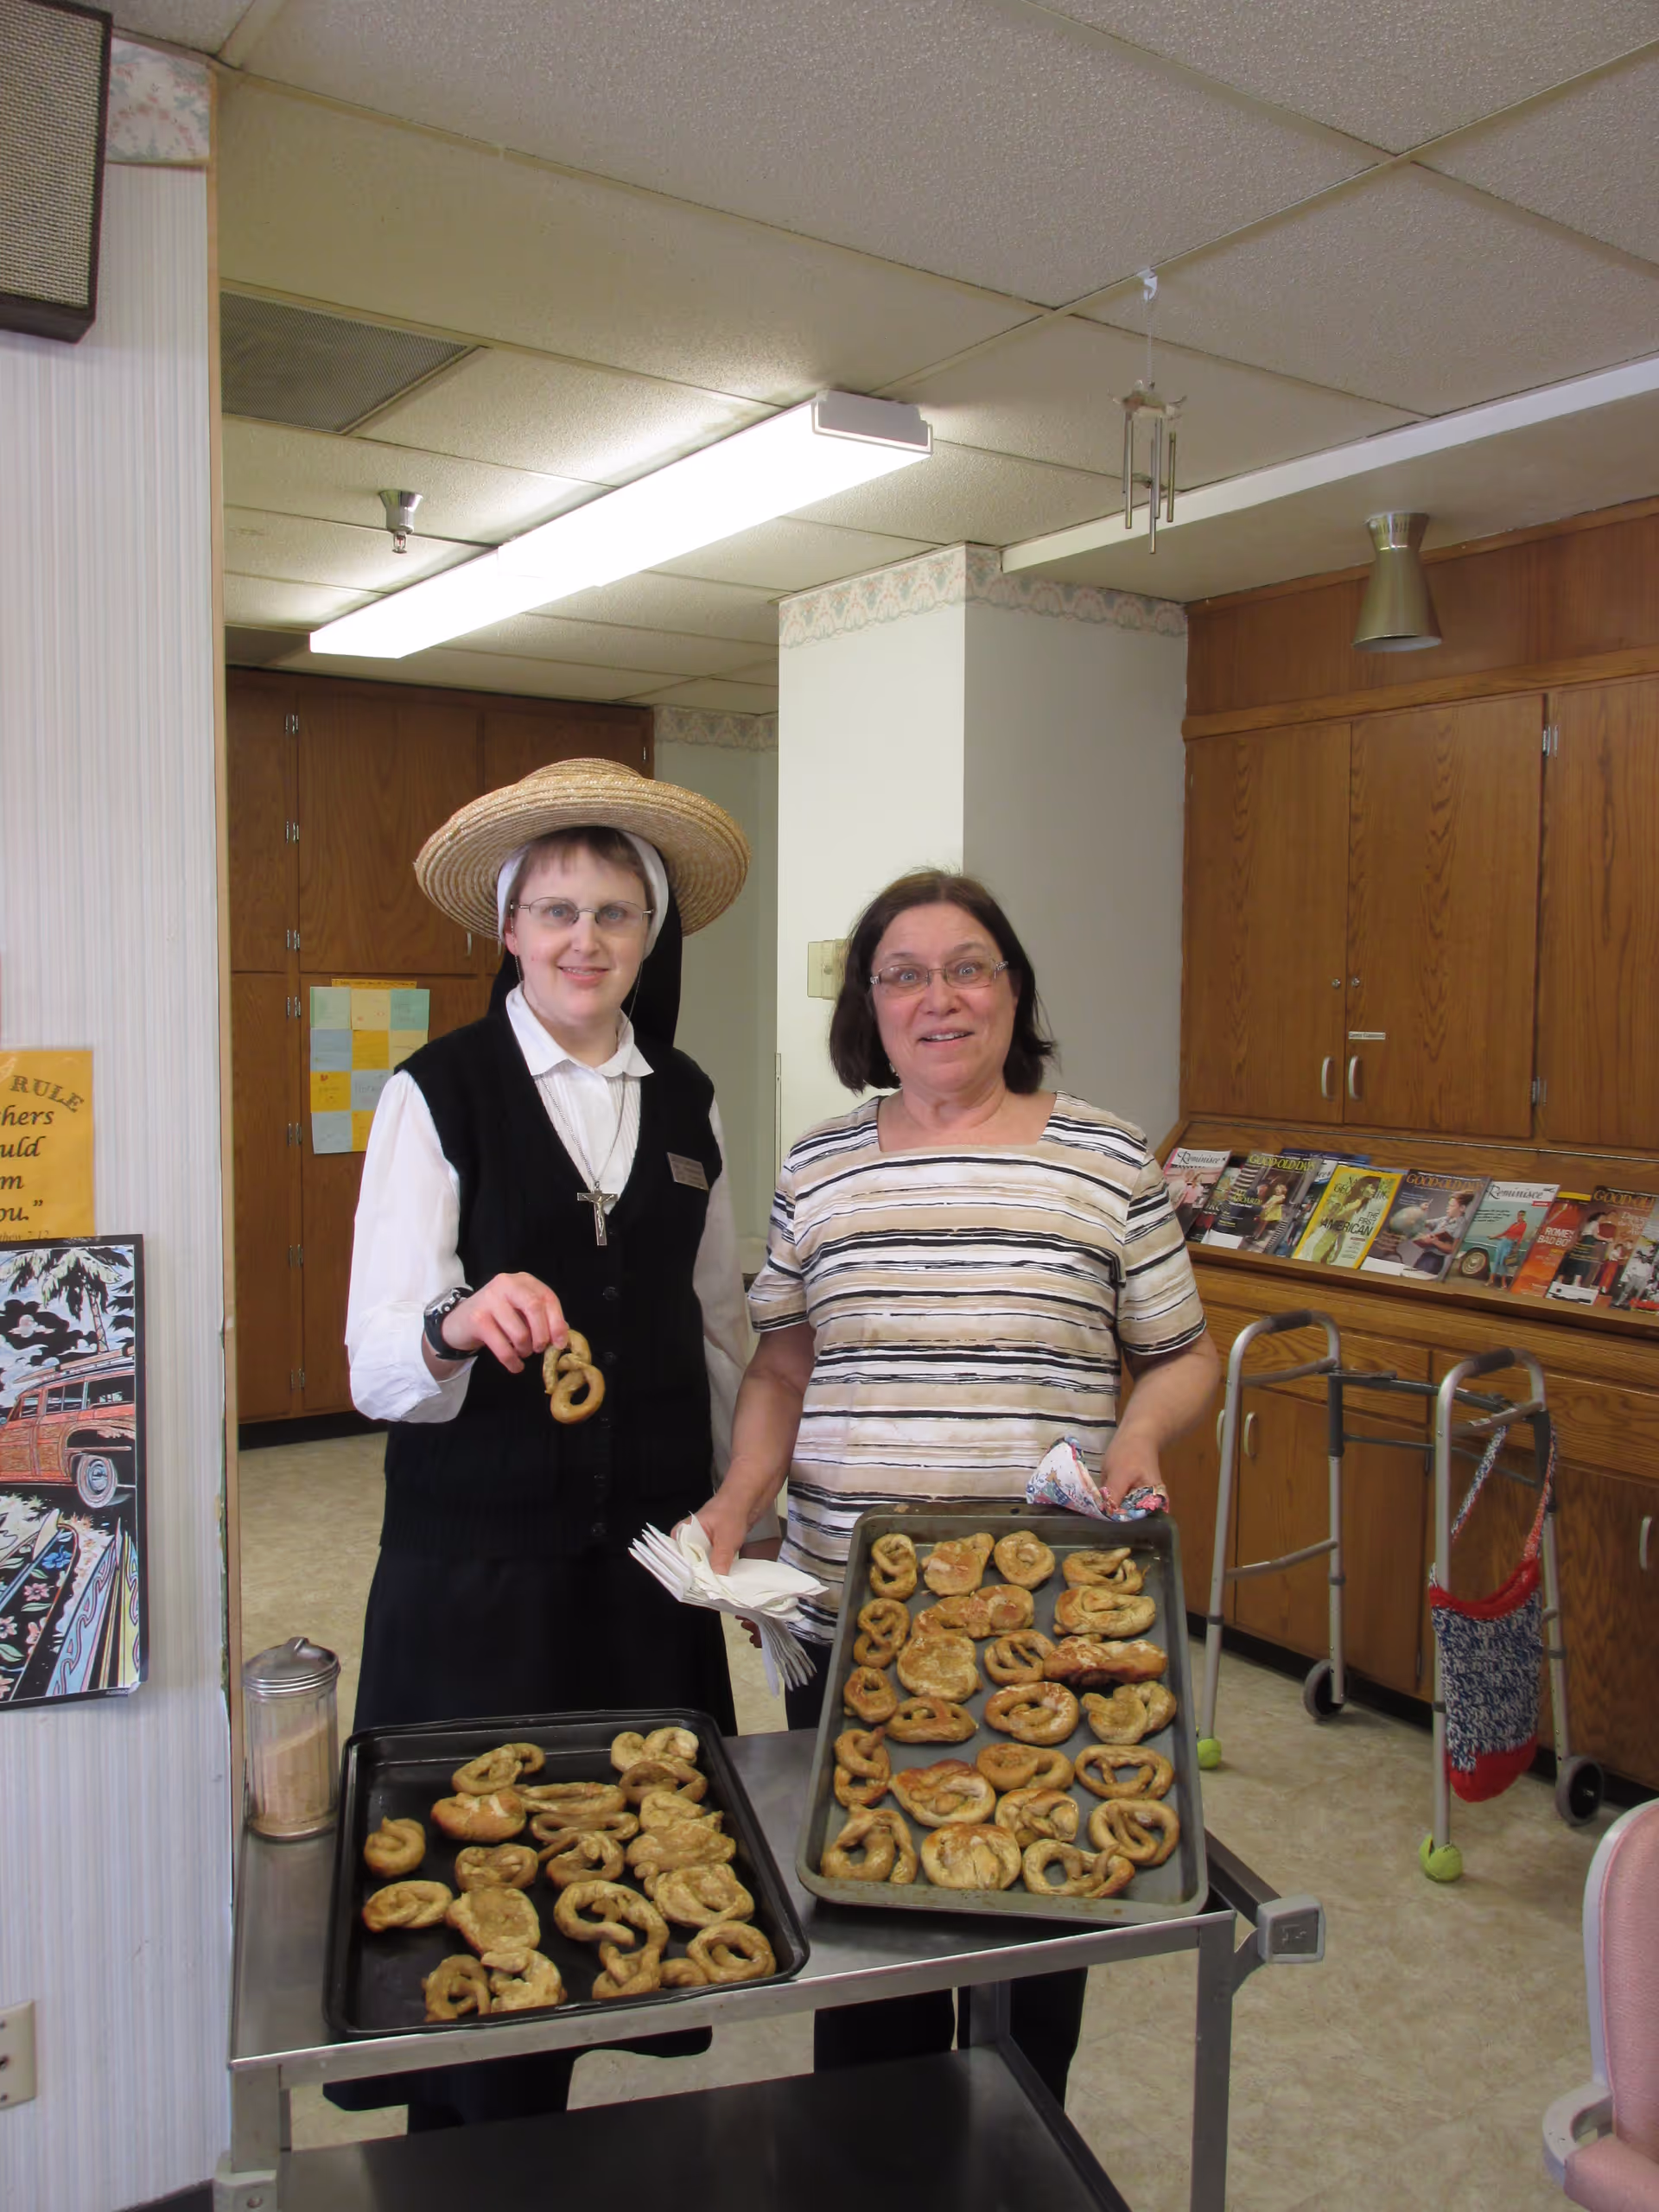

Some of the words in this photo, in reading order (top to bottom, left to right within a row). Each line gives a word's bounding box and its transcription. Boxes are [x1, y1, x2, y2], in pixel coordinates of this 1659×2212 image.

[10, 1075, 84, 1113] RULE
[0, 1104, 54, 1126] hers
[0, 1136, 46, 1158] uld
[1177, 1151, 1220, 1164] Reminisce
[1249, 1154, 1277, 1166] GOOD
[1278, 1159, 1296, 1169] OLD
[1407, 1173, 1438, 1187] GOOD
[1486, 1185, 1544, 1199] Reminisce
[1595, 1191, 1631, 1204] GOOD
[1321, 1218, 1373, 1236] AMERICAN
[1537, 1235, 1554, 1244] BAD
